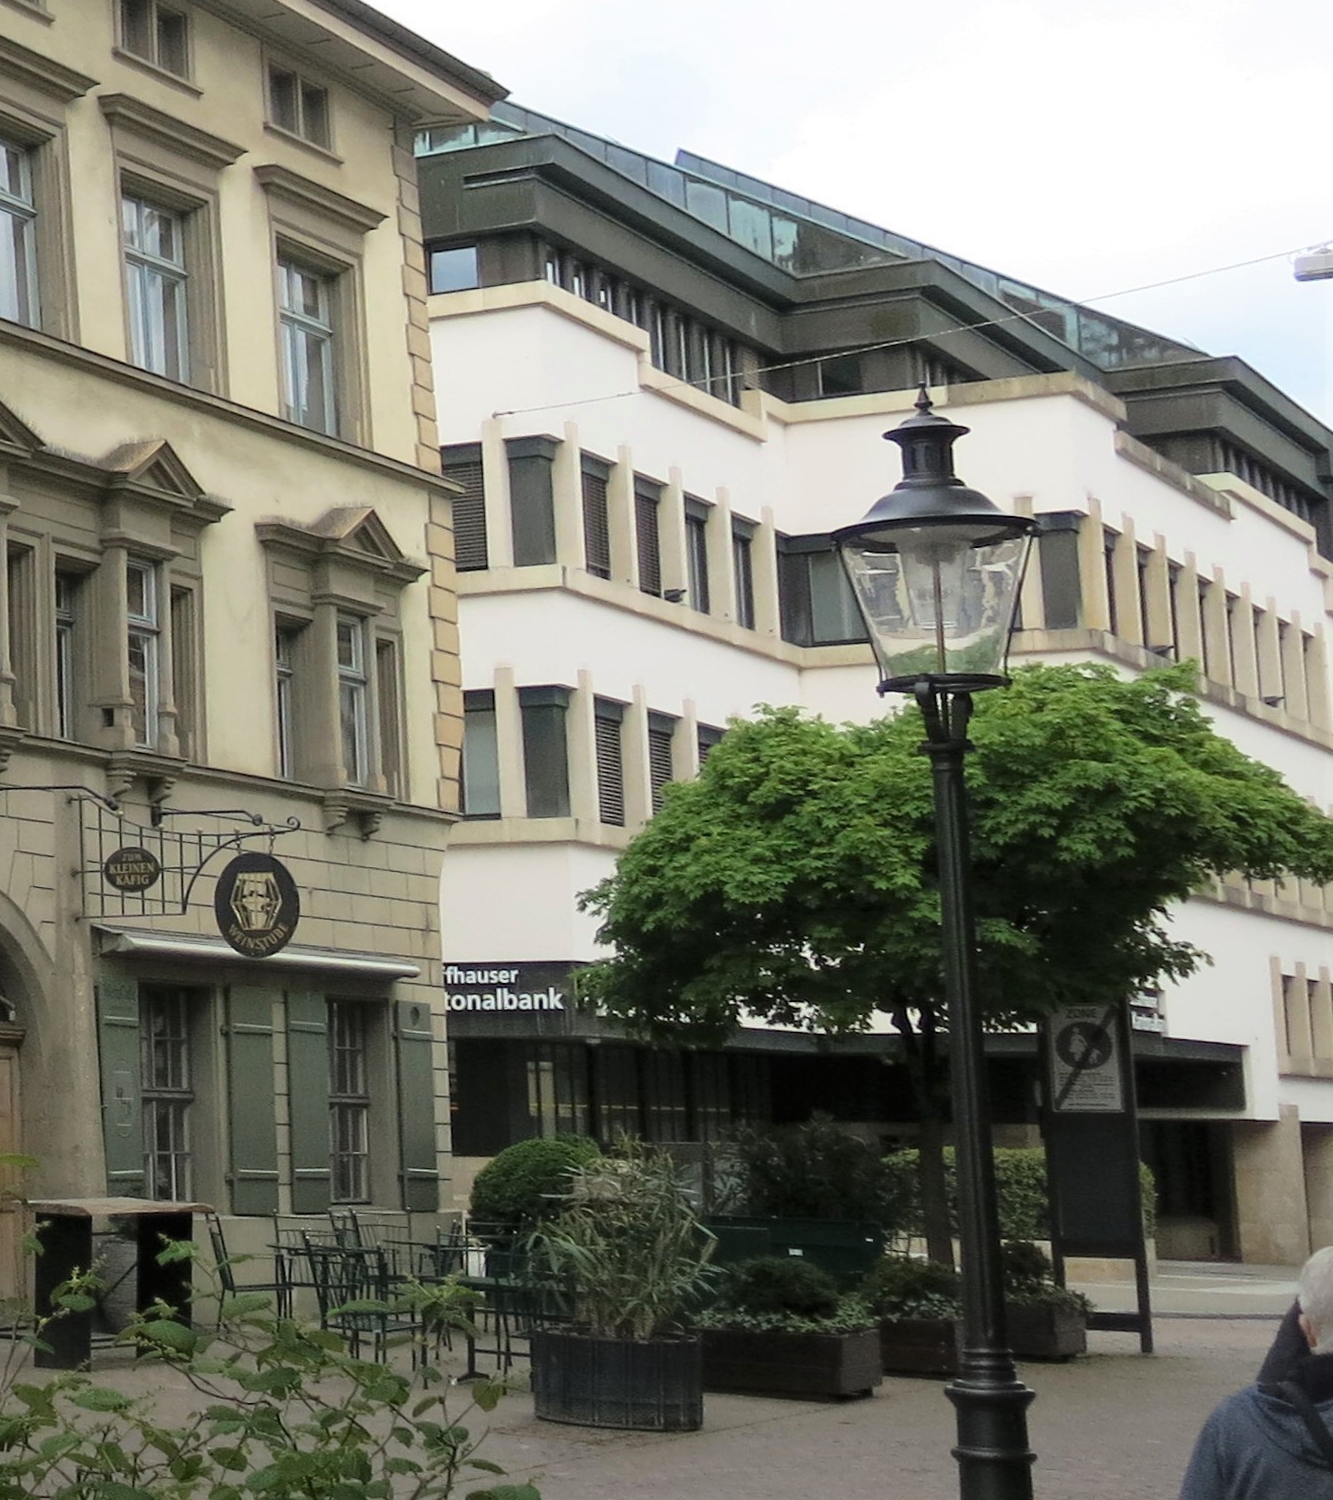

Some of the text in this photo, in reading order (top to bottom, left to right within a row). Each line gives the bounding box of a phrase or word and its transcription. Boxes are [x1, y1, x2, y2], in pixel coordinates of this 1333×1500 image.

[122, 853, 143, 862] ZUM
[109, 862, 156, 874] KLEINEN
[115, 873, 150, 886] KÄFIG
[229, 921, 289, 952] WEINSTUBE
